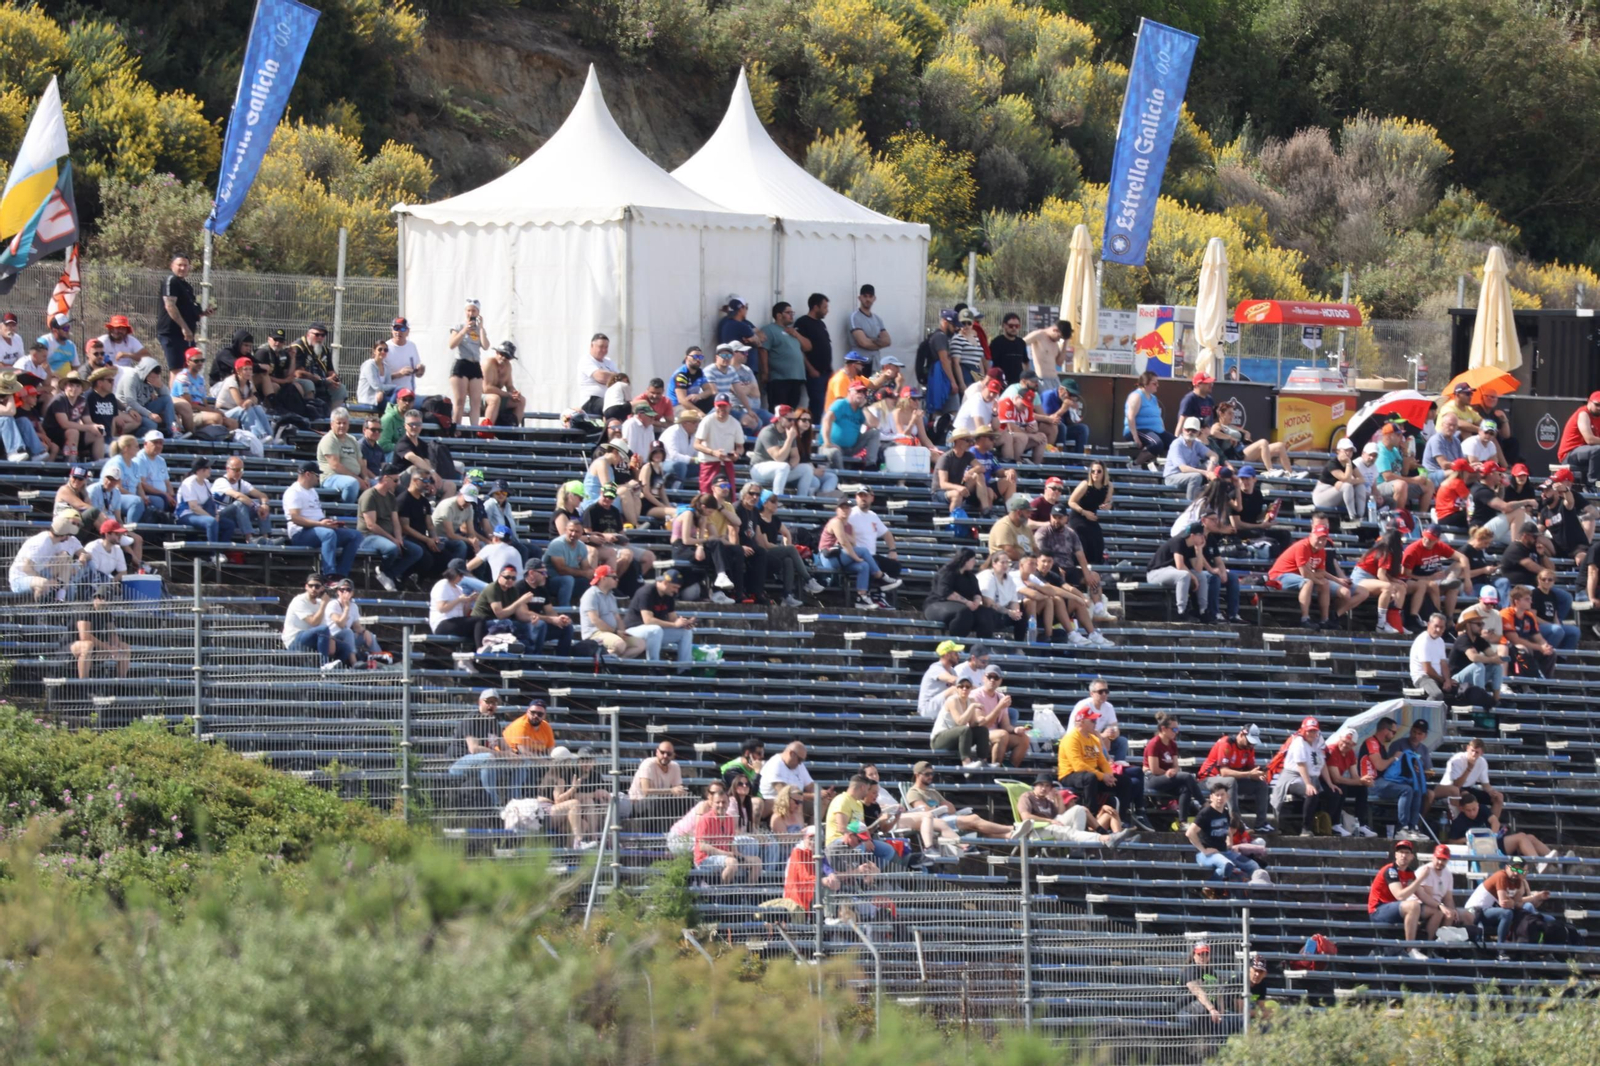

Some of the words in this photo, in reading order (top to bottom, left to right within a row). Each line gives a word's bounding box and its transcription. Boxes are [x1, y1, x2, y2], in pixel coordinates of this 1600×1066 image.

[246, 59, 280, 126] Galicia
[273, 22, 292, 48] 0,0
[1116, 158, 1150, 232] Estrella
[1134, 88, 1165, 154] Galicia
[1155, 49, 1171, 75] 0,0
[1139, 308, 1155, 318] Red
[1157, 308, 1173, 318] Bull
